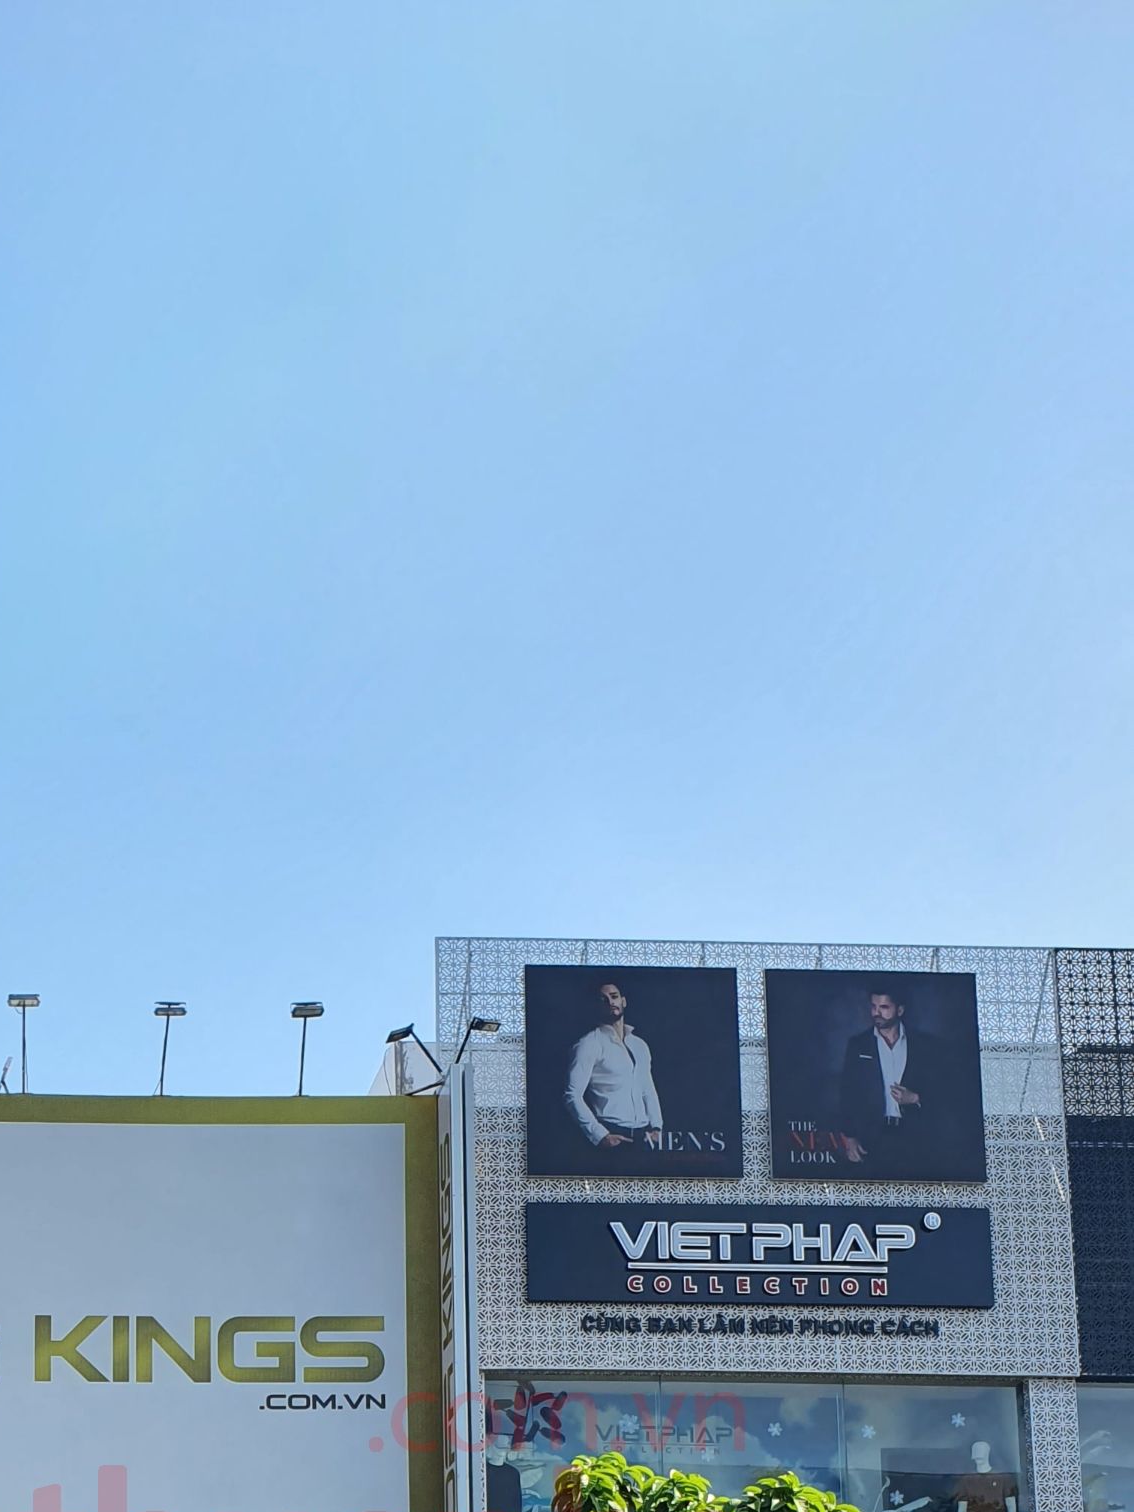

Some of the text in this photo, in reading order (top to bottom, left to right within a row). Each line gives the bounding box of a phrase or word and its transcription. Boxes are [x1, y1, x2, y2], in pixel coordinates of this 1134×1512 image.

[789, 1121, 817, 1132] THE
[790, 1150, 836, 1163] LOOK
[439, 1136, 455, 1348] KINGS
[609, 1221, 916, 1262] VIETPHAP
[627, 1275, 888, 1296] COLLECTION
[33, 1314, 386, 1384] KINGS
[258, 1393, 387, 1411] .COM.VN
